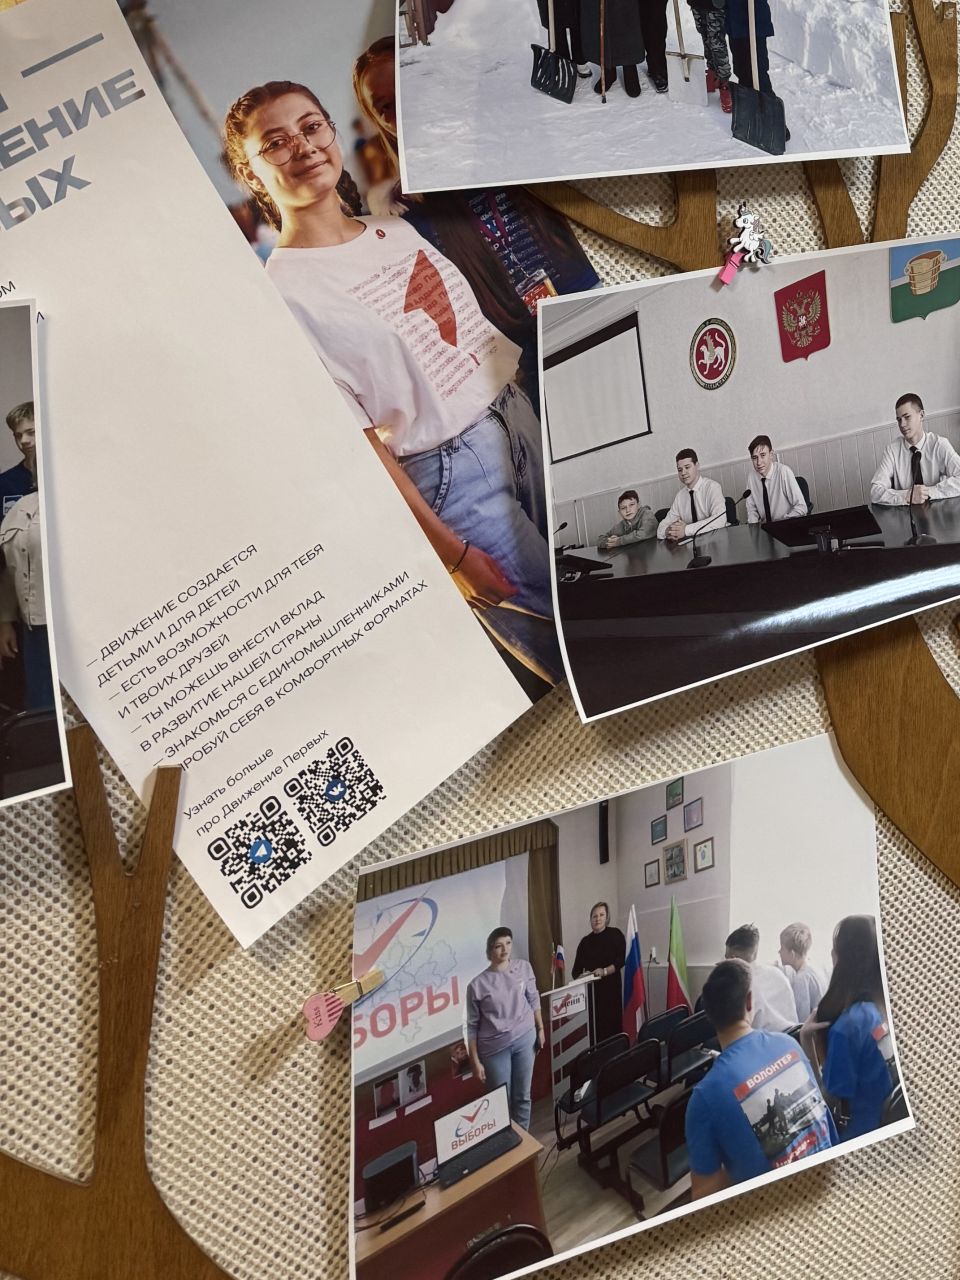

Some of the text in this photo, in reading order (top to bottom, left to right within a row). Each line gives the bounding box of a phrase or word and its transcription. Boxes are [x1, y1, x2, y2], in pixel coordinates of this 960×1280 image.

[0, 68, 146, 169] ЕНИЕ
[0, 154, 92, 231] ЫХ
[97, 578, 241, 688] ДЕТЬМИ И ДЛЯ ДЕТЕЙ
[100, 544, 258, 661] ДВИЖЕНИЕ СОЗДАЕТСЯ
[120, 543, 325, 693] ЕСТЬ ВОЗМОЖНОСТИ ДЛЯ ТЕБЯ
[118, 634, 231, 719] И ТВОИХ ДРУЗЕЙ
[139, 614, 323, 752] В РАЗВИТИЕ НАШЕЙ СТРАНЫ
[142, 590, 325, 725] ТЫ МОЖЕШЬ ВНЕСТИ ВКЛАД
[164, 571, 410, 759] ЗНАКОМЬСЯ С ЕДИНОМЫШЛЕННИКАМИ
[229, 704, 265, 734] СЕБЯ
[264, 696, 276, 707] В
[276, 629, 364, 699] КОМФОРТНЫХ
[363, 580, 429, 633] ФОРМАТАХ
[184, 747, 274, 820] Узнать больше
[196, 730, 329, 836] про Движение Первых
[353, 976, 460, 1049] БОРЫ
[451, 1119, 497, 1152] ВЫБОРЫ
